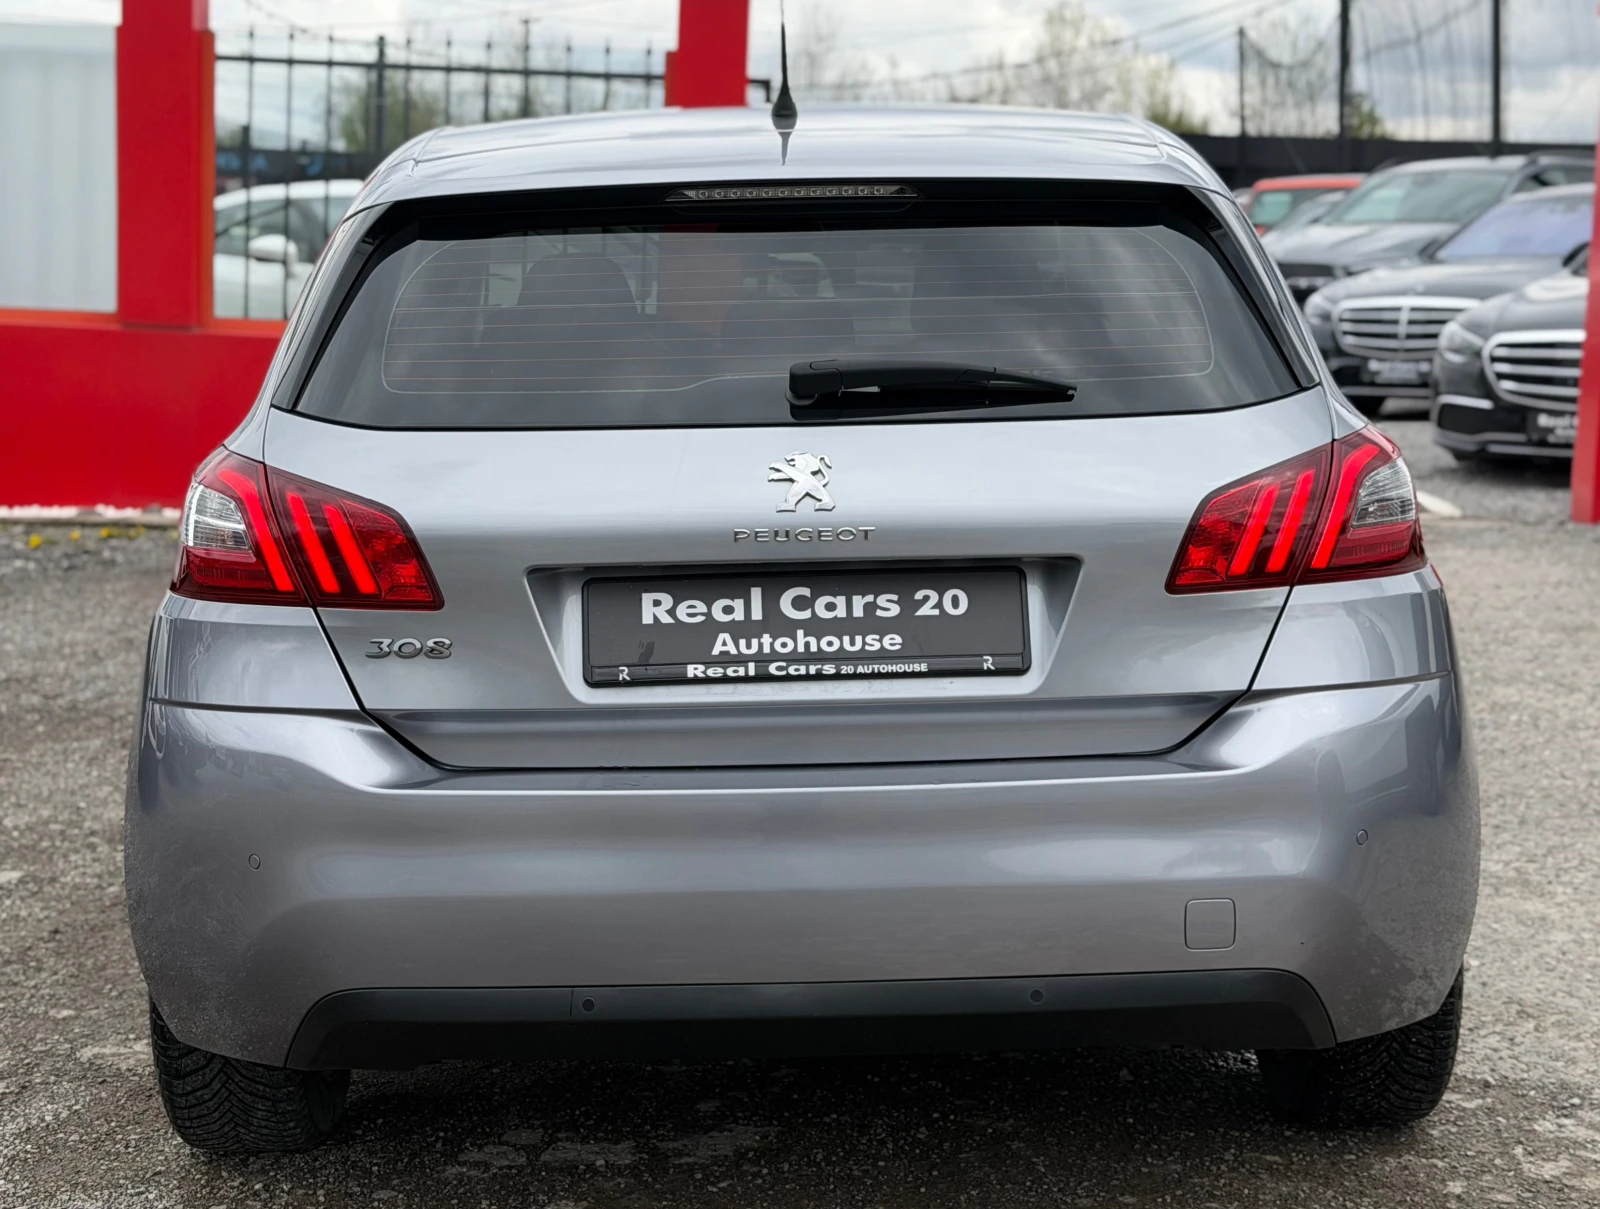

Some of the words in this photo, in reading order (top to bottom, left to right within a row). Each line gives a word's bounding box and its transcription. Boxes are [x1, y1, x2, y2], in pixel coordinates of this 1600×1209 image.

[733, 526, 876, 543] PEUGEOT
[641, 587, 763, 625] Real
[779, 586, 901, 620] Cars
[914, 588, 969, 616] 20
[364, 637, 453, 660] 308
[711, 629, 903, 656] Autohouse
[686, 661, 756, 678] Real
[768, 661, 837, 676] Cars
[840, 664, 855, 675] 20
[856, 662, 929, 674] AUTOHOUSE
